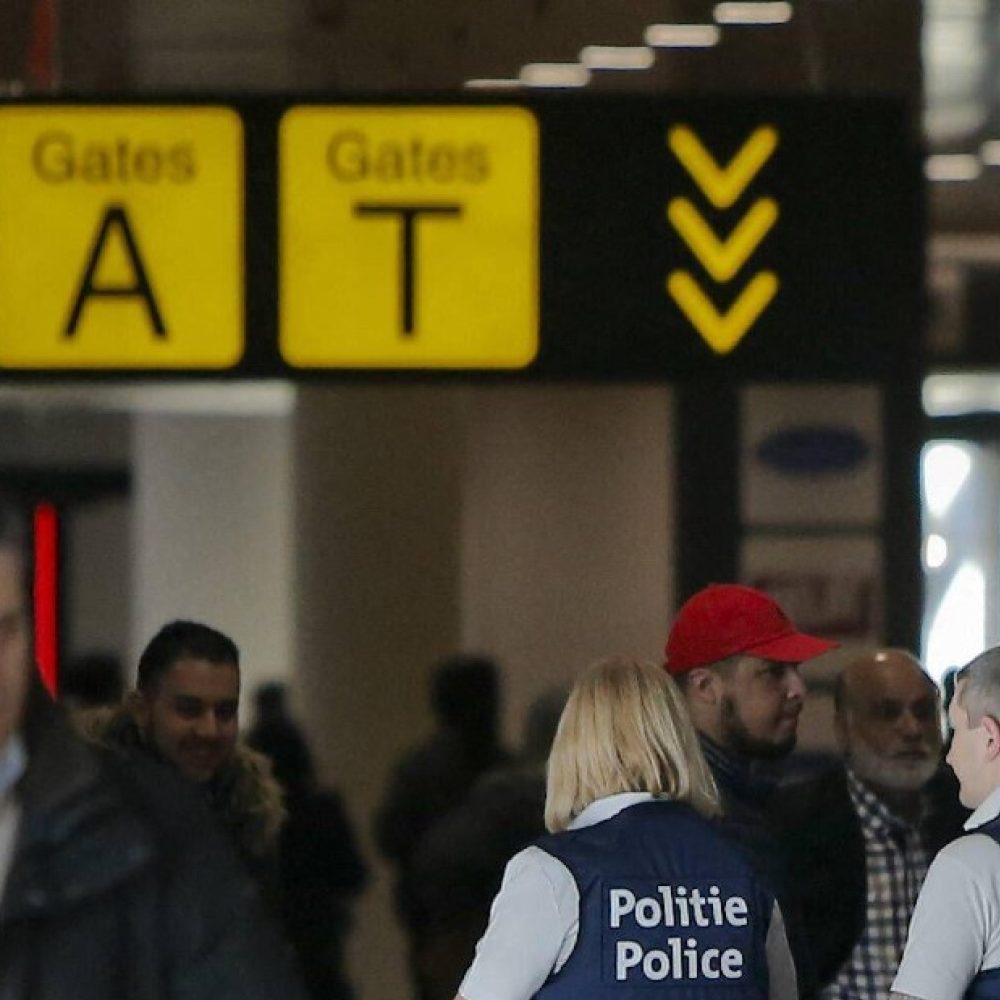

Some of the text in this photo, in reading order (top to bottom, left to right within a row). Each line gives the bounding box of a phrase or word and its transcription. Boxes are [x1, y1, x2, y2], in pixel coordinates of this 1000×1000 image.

[31, 130, 196, 186] Gates
[325, 130, 491, 186] Gates
[61, 202, 170, 342] A
[352, 202, 464, 338] T
[610, 885, 748, 929] Politie
[616, 937, 743, 981] Police
